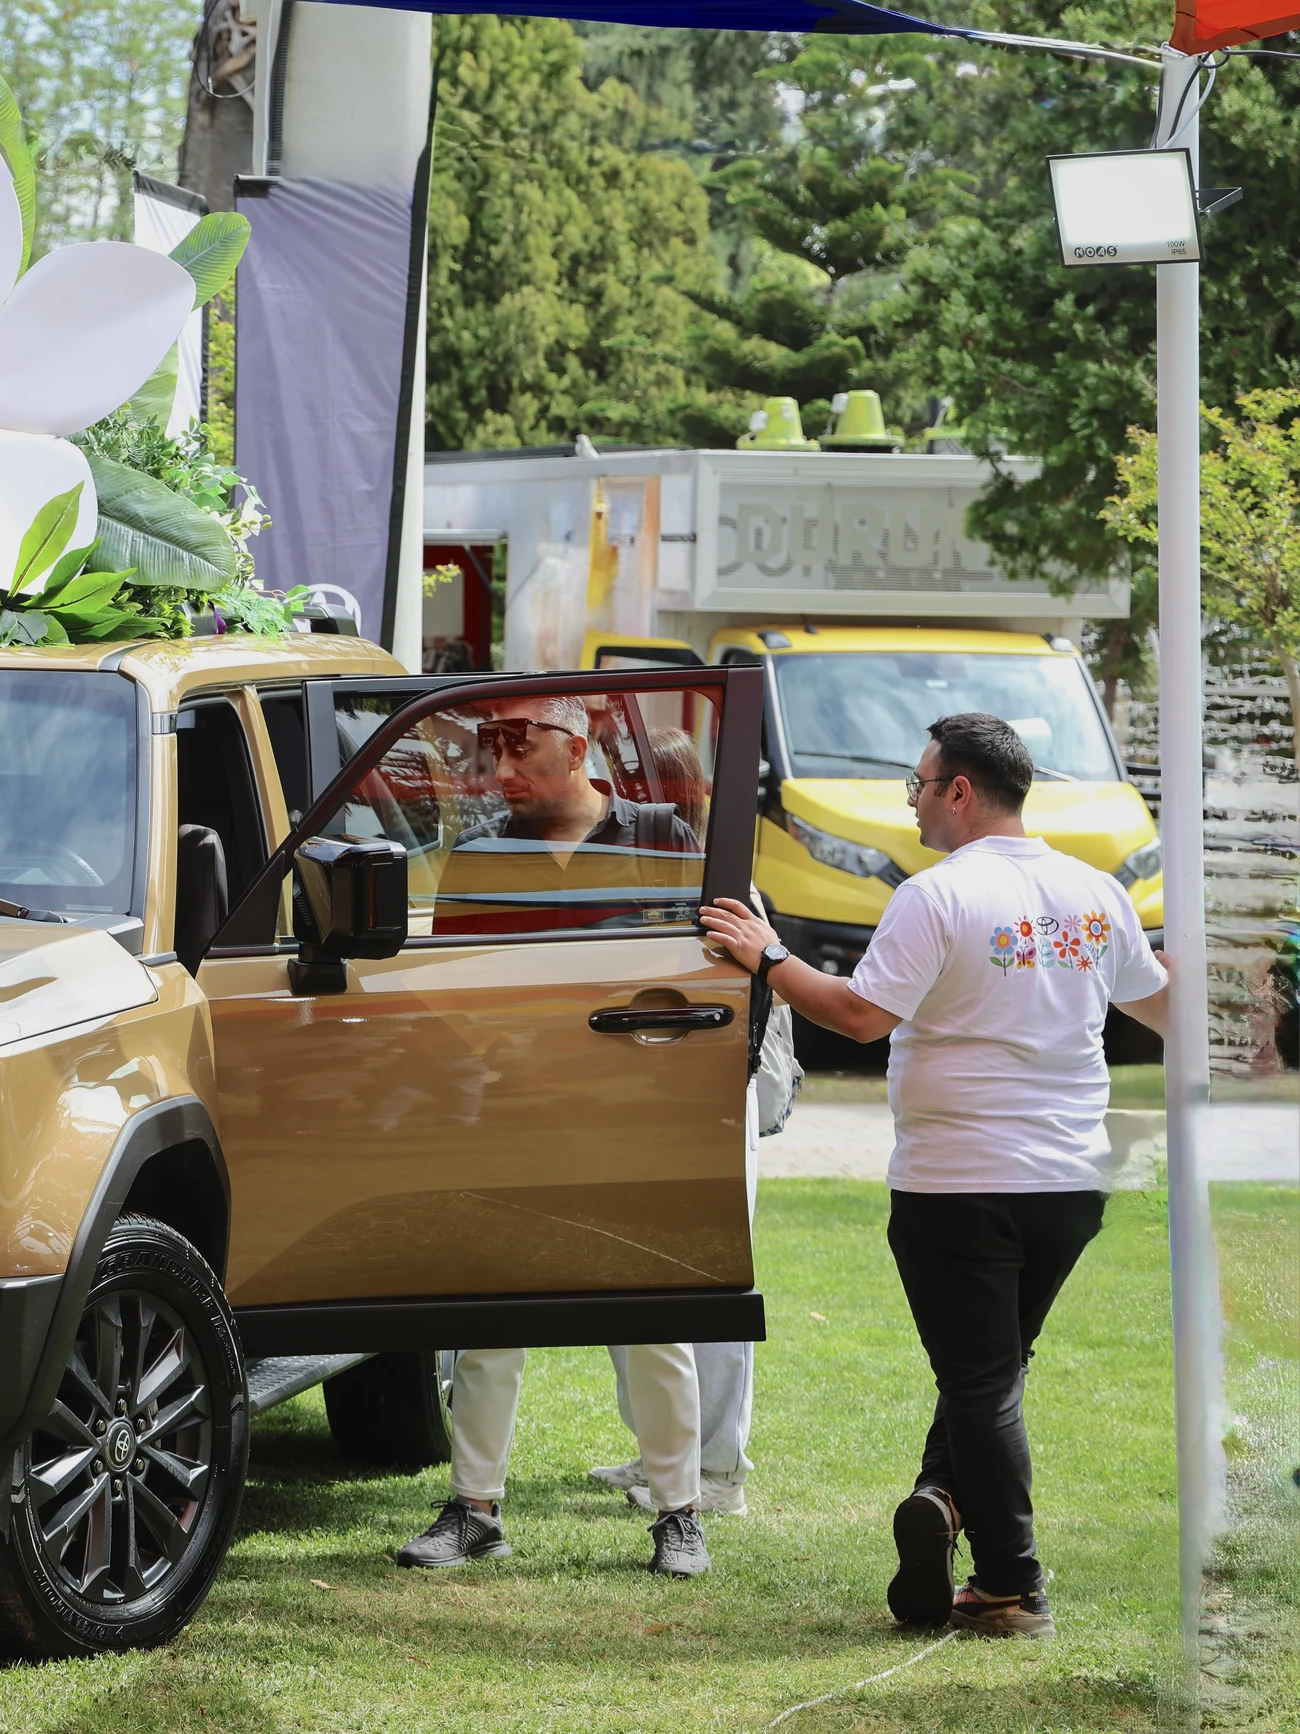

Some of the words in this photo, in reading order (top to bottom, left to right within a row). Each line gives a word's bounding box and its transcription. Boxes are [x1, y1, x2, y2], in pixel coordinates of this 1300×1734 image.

[1166, 240, 1186, 248] 100W
[1074, 245, 1117, 258] NOAS
[1171, 248, 1187, 256] IP65
